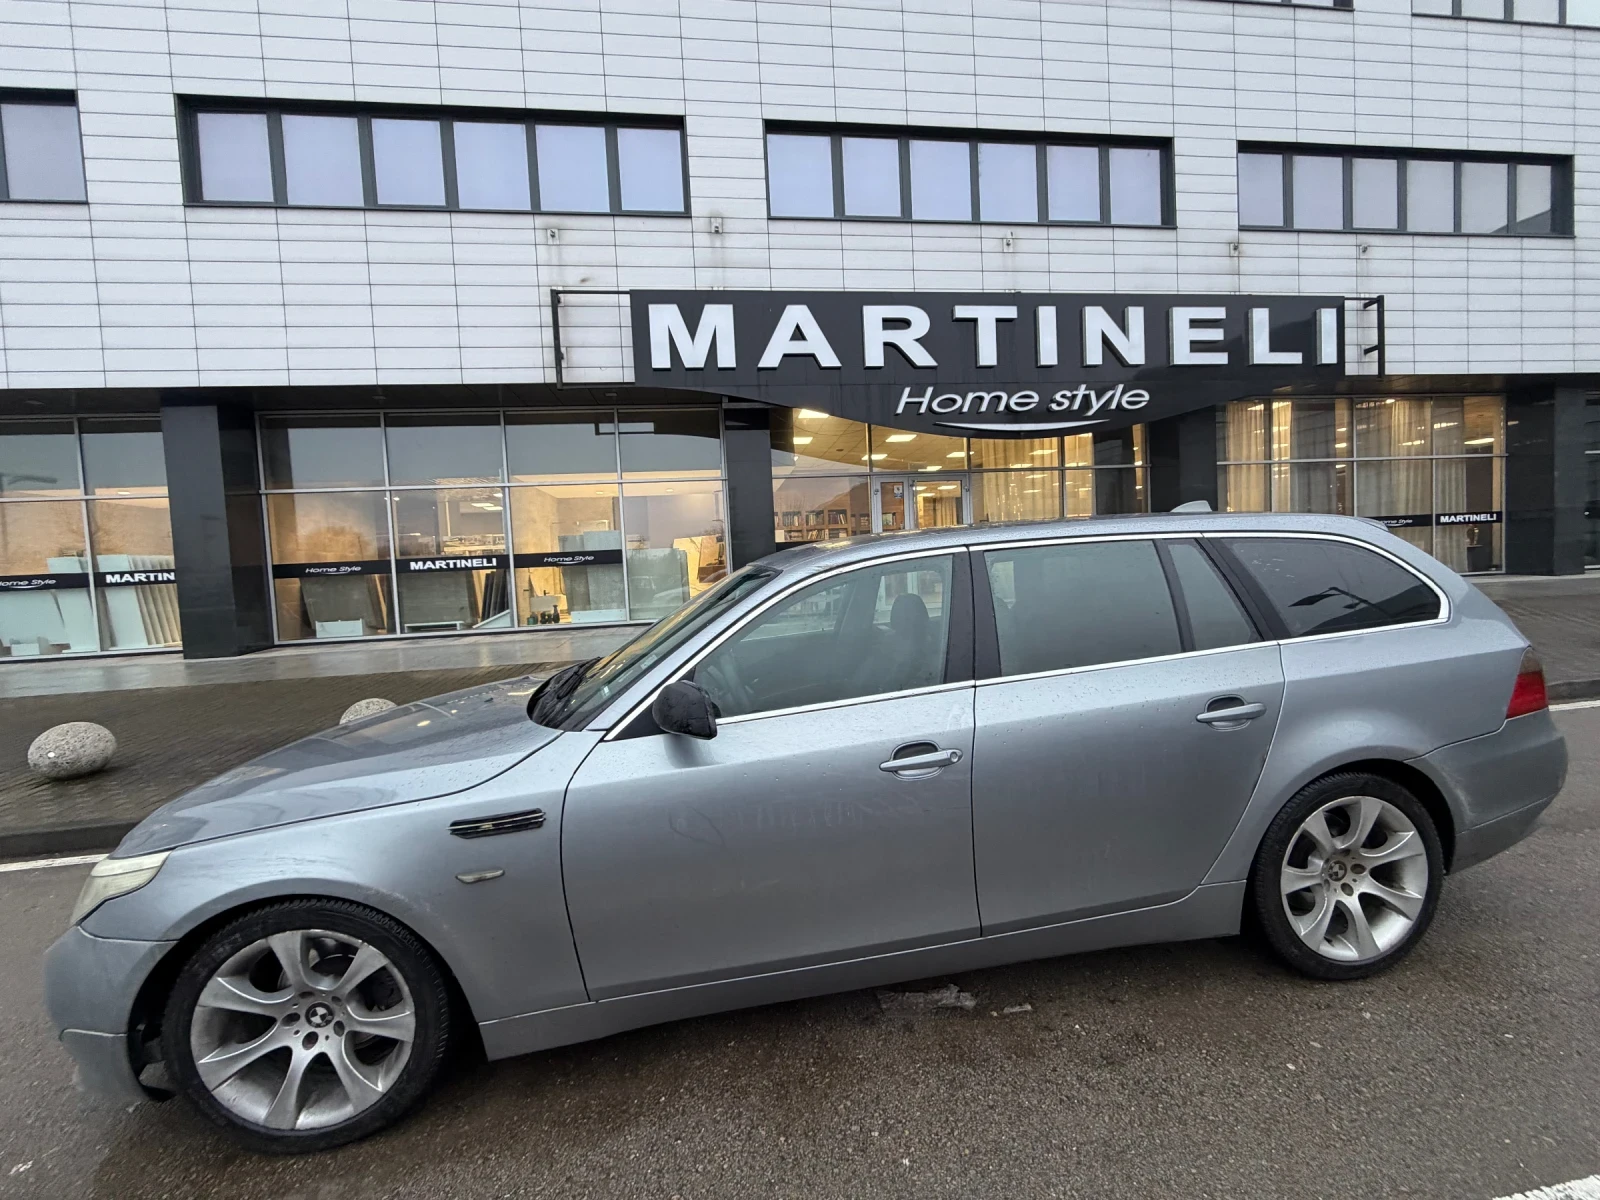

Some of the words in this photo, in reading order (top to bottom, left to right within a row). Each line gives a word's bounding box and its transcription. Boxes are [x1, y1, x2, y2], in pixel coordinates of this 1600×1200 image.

[647, 303, 1338, 369] MARTINELI
[895, 386, 1040, 417] Home
[1049, 383, 1150, 417] style
[1440, 513, 1497, 523] MARTINELI
[339, 565, 362, 573] Style
[409, 557, 497, 571] MARTINELI
[31, 578, 57, 586] Style
